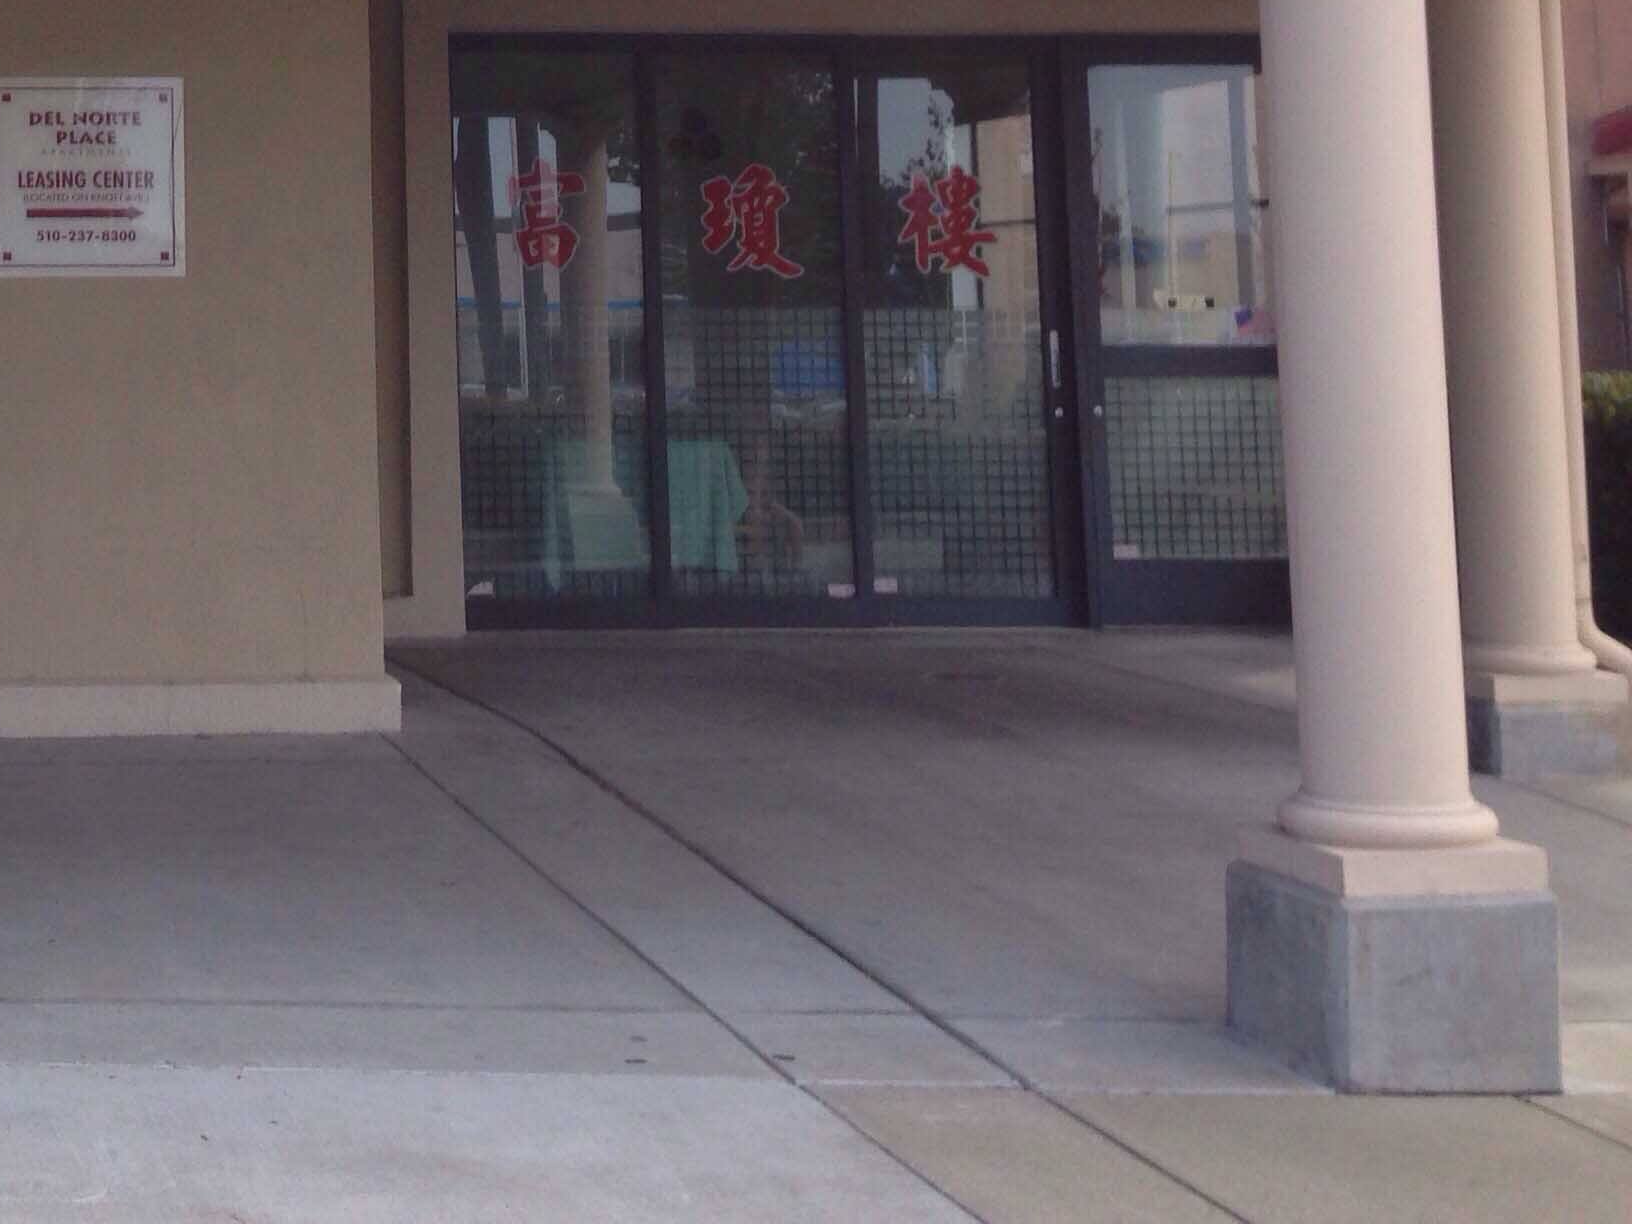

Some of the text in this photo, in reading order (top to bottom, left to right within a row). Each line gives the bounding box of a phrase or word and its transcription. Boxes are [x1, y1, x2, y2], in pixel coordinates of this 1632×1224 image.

[29, 111, 142, 127] DEL NORTE
[56, 130, 118, 145] PLACE
[18, 171, 155, 189] LEASING CENTER
